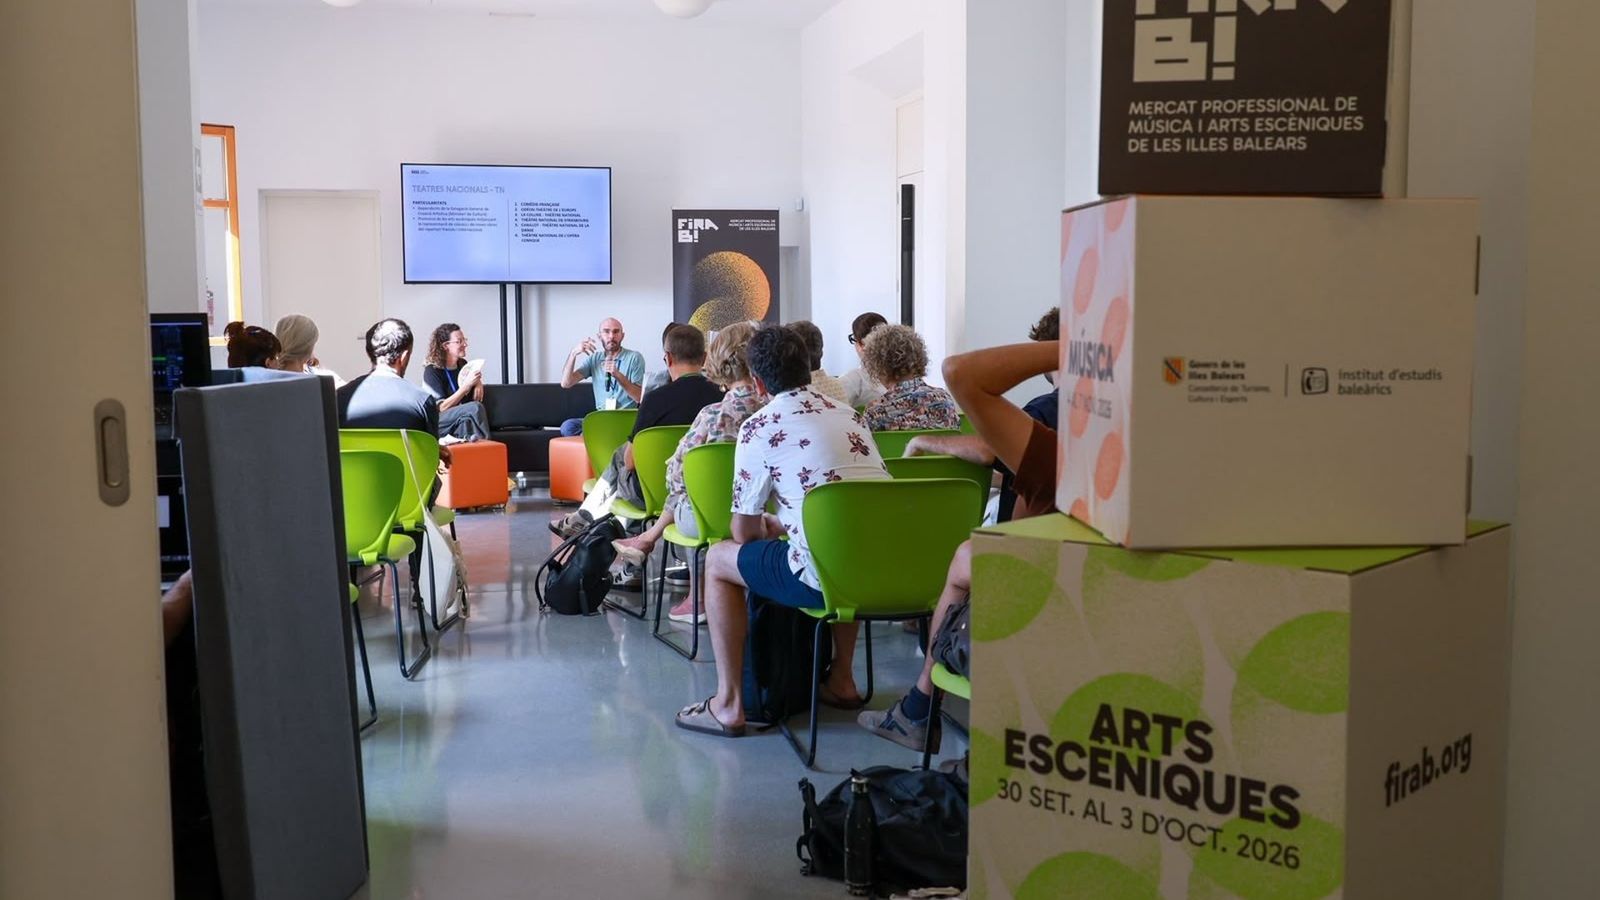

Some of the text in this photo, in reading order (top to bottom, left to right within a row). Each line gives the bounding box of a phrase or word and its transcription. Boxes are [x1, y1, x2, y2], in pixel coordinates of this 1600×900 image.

[1133, 16, 1237, 82] B!
[1128, 96, 1358, 115] MERCAT PROFESSIONAL DE
[1128, 113, 1364, 134] MÚSICA I ARTS ESCÈNIQUES
[1128, 136, 1307, 153] DE LES ILLES BALEARS
[412, 184, 444, 193] TEATRES
[446, 185, 489, 194] NACIONALS
[495, 186, 505, 194] TN
[1189, 360, 1246, 369] Govern de les
[1211, 371, 1246, 380] Balears
[1388, 368, 1443, 381] d'estudis
[1089, 703, 1214, 764] ARTS
[1384, 732, 1472, 808] firab.org
[998, 778, 1300, 870] 30 SET. AL 3 D'OCT. 2026
